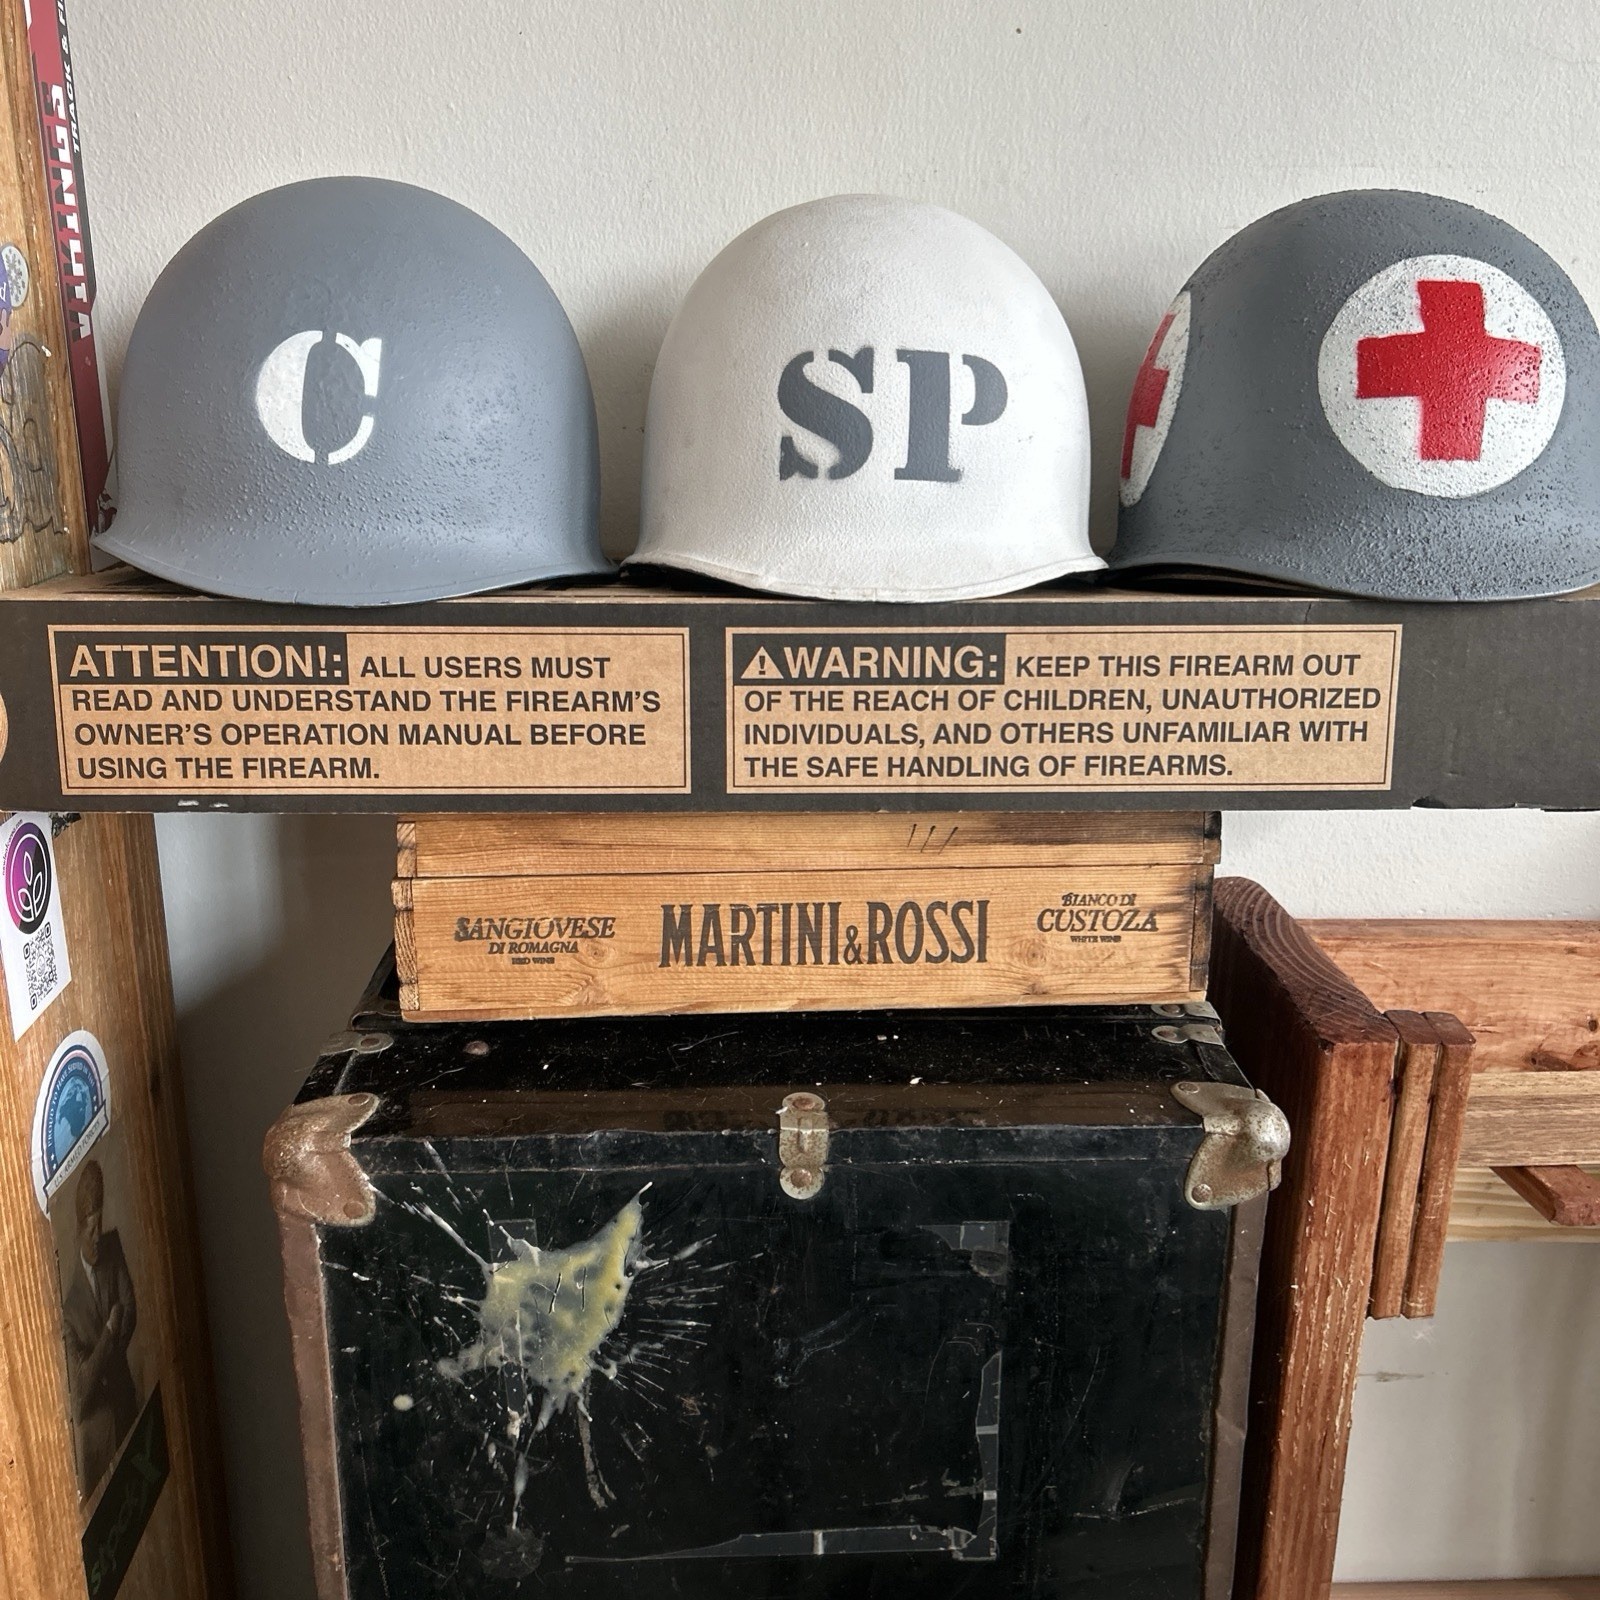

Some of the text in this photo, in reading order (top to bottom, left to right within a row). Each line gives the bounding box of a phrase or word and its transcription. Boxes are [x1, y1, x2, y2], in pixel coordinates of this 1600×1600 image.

[61, 34, 69, 54] &
[64, 61, 81, 153] TRACK
[41, 81, 91, 342] VIKINGS
[256, 330, 382, 465] C
[777, 346, 1009, 483] SP
[70, 645, 610, 678] ATTENTION!: ALL USERS MUST
[783, 645, 1360, 678] WARNING: KEEP THIS FIREARM OUT
[72, 690, 660, 712] READ AND UNDERSTAND THE FIREARM'S
[745, 688, 1380, 714] OF THE REACH OF CHILDREN, UNAUTHORIZED
[75, 724, 645, 745] OWNER'S OPERATION MANUAL BEFORE
[745, 721, 1367, 748] INDIVIDUALS, AND OTHERS UNFAMILIAR WITH
[78, 757, 379, 779] USING THE FIREARM.
[744, 755, 1232, 777] THE SAFE HANDLING OF FIREARMS.
[1061, 892, 1138, 907] BIANCO DI
[454, 916, 616, 942] SANGIOVESE
[1036, 908, 1159, 933] CUSTOZA
[488, 941, 580, 955] DI ROMAGNA
